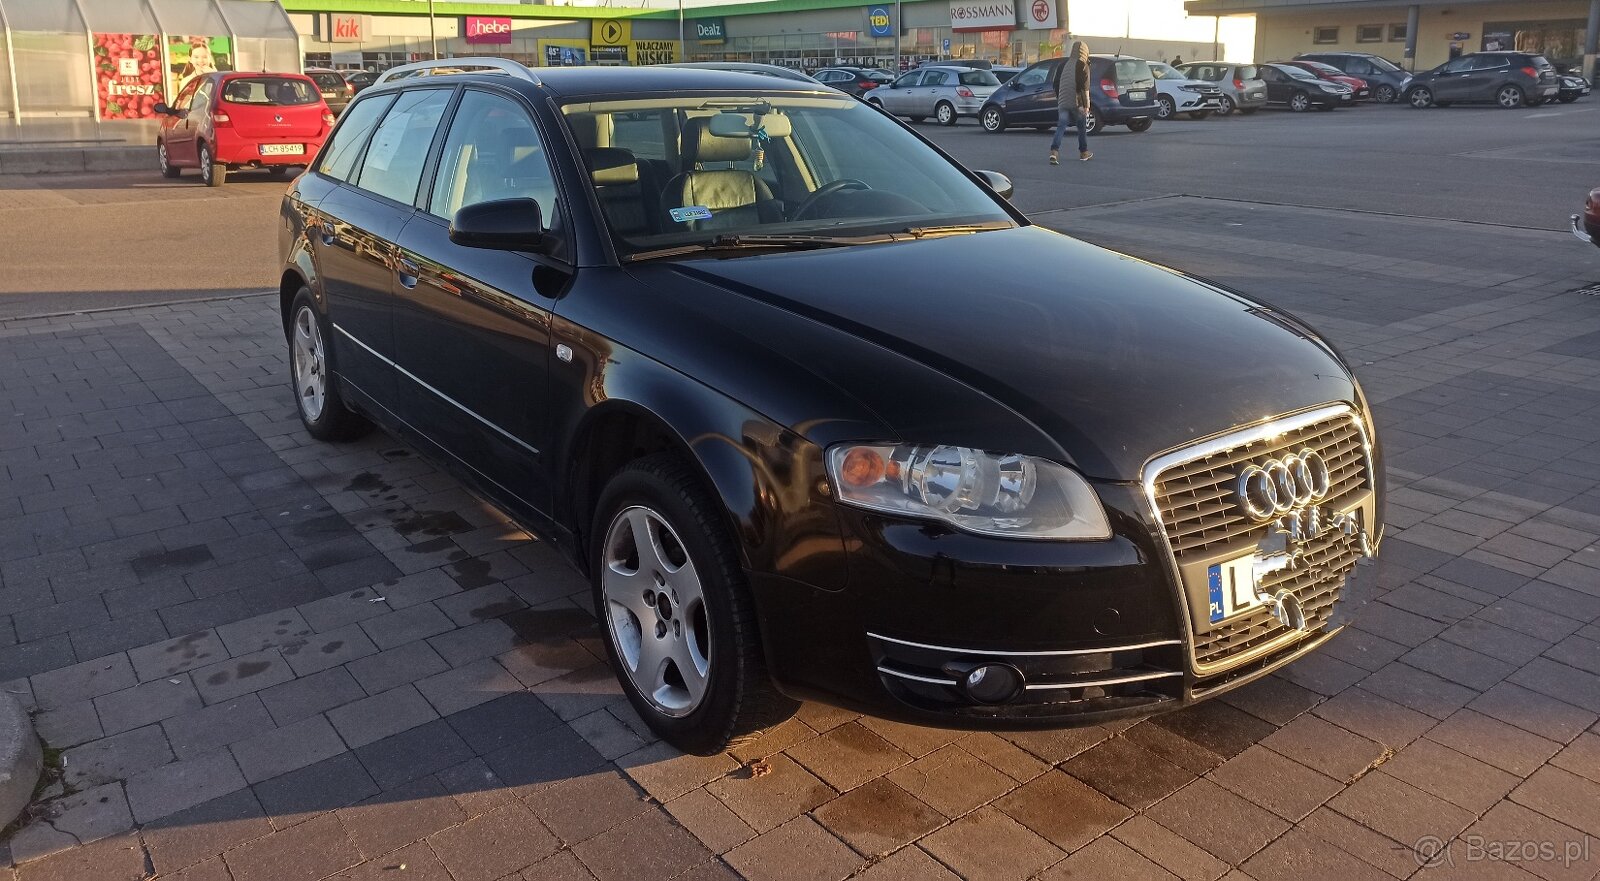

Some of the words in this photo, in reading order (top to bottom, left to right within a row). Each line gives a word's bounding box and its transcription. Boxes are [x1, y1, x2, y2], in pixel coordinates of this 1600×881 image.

[951, 4, 1013, 20] ROSSMANN
[335, 17, 359, 38] kik
[476, 19, 511, 34] hebe
[697, 23, 721, 36] Dealz
[108, 79, 155, 96] fresz
[1209, 601, 1222, 616] PL
